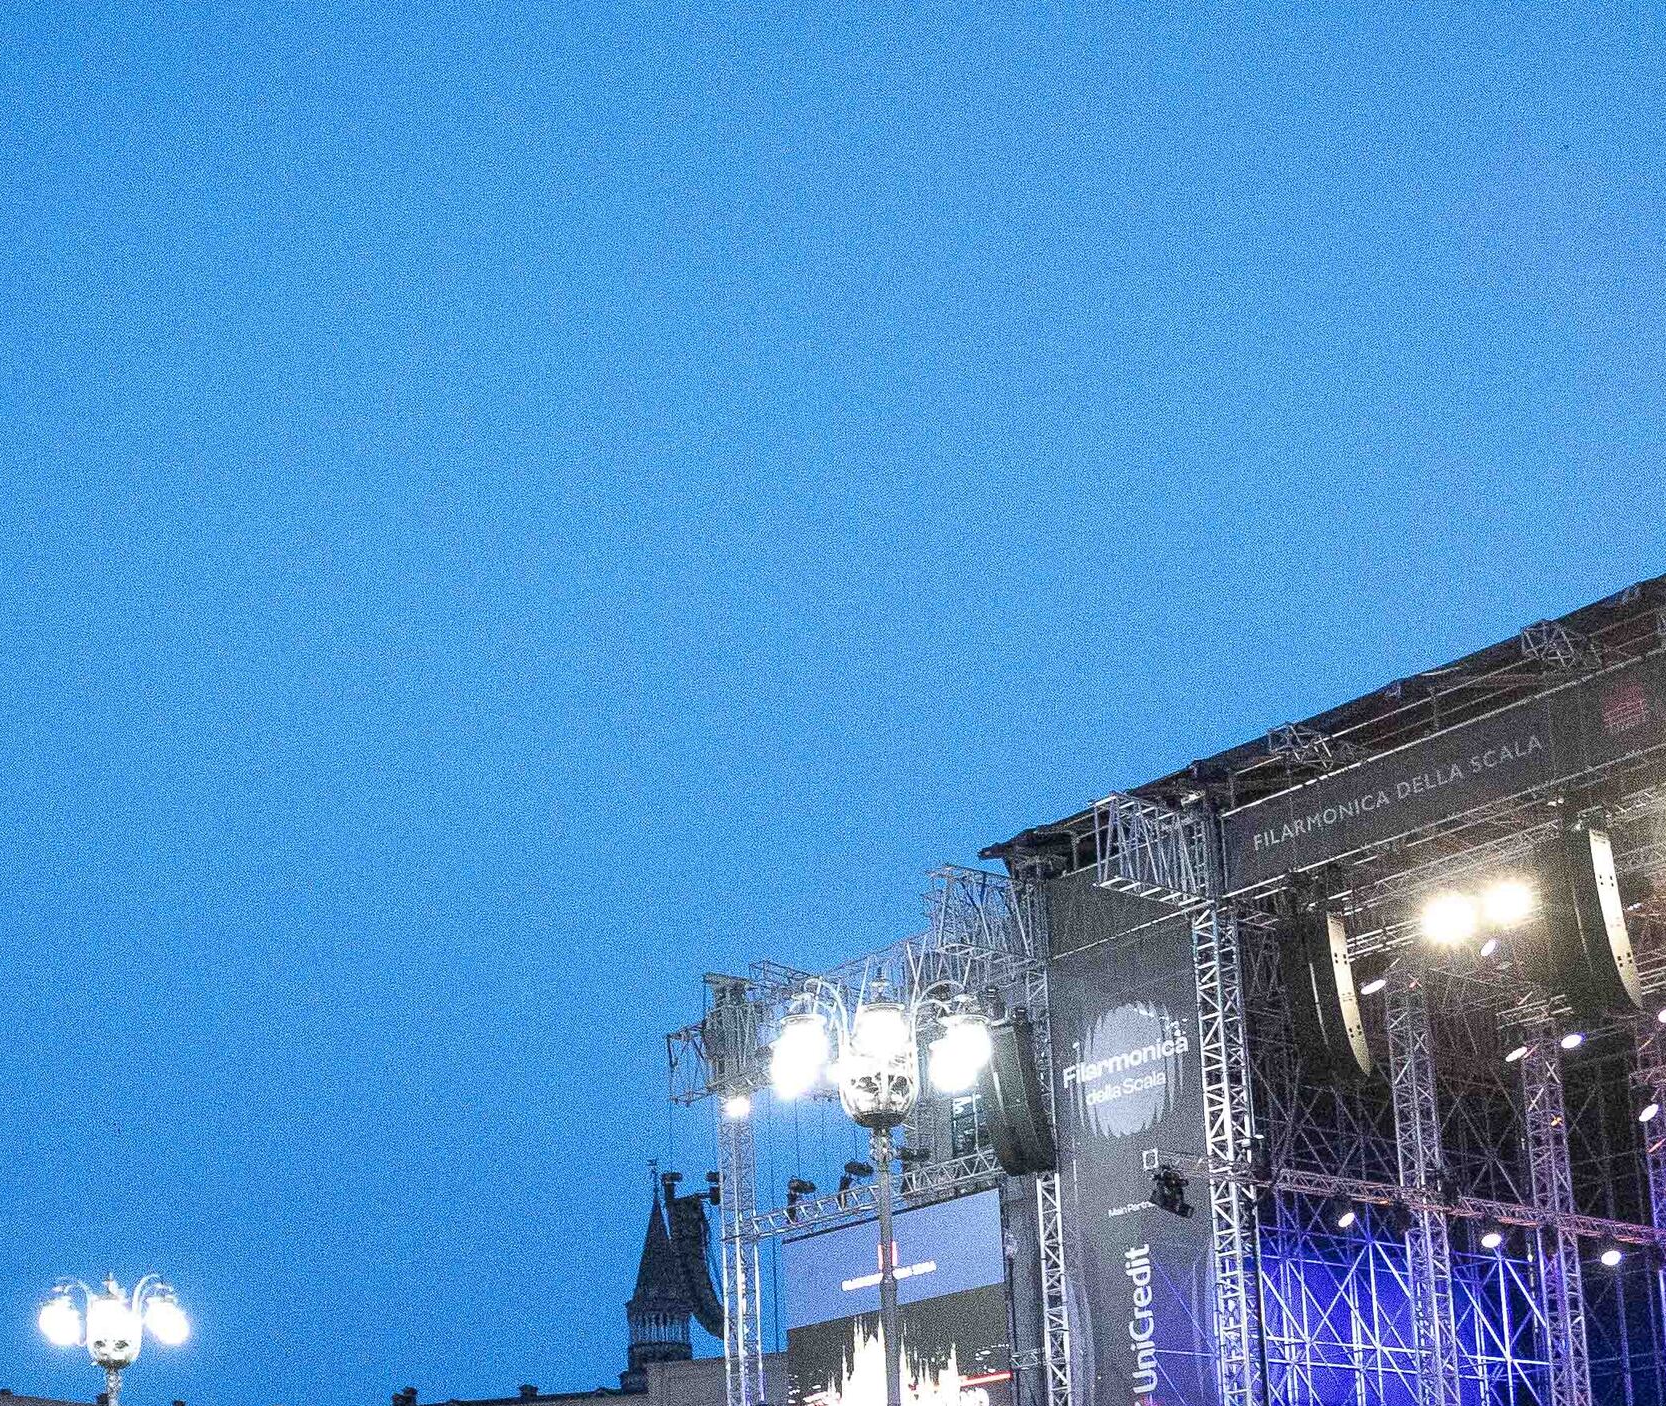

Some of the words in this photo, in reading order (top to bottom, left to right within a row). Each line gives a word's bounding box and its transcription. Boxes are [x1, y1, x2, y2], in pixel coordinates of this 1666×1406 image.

[1252, 789, 1391, 851] FILARMONICA
[1395, 763, 1466, 800] DELLA
[1470, 734, 1544, 774] SCALA
[1063, 1034, 1189, 1089] Filarmonica
[1085, 1080, 1123, 1106] della
[1122, 1070, 1167, 1095] Scala
[1125, 1243, 1158, 1394] UniCredit
